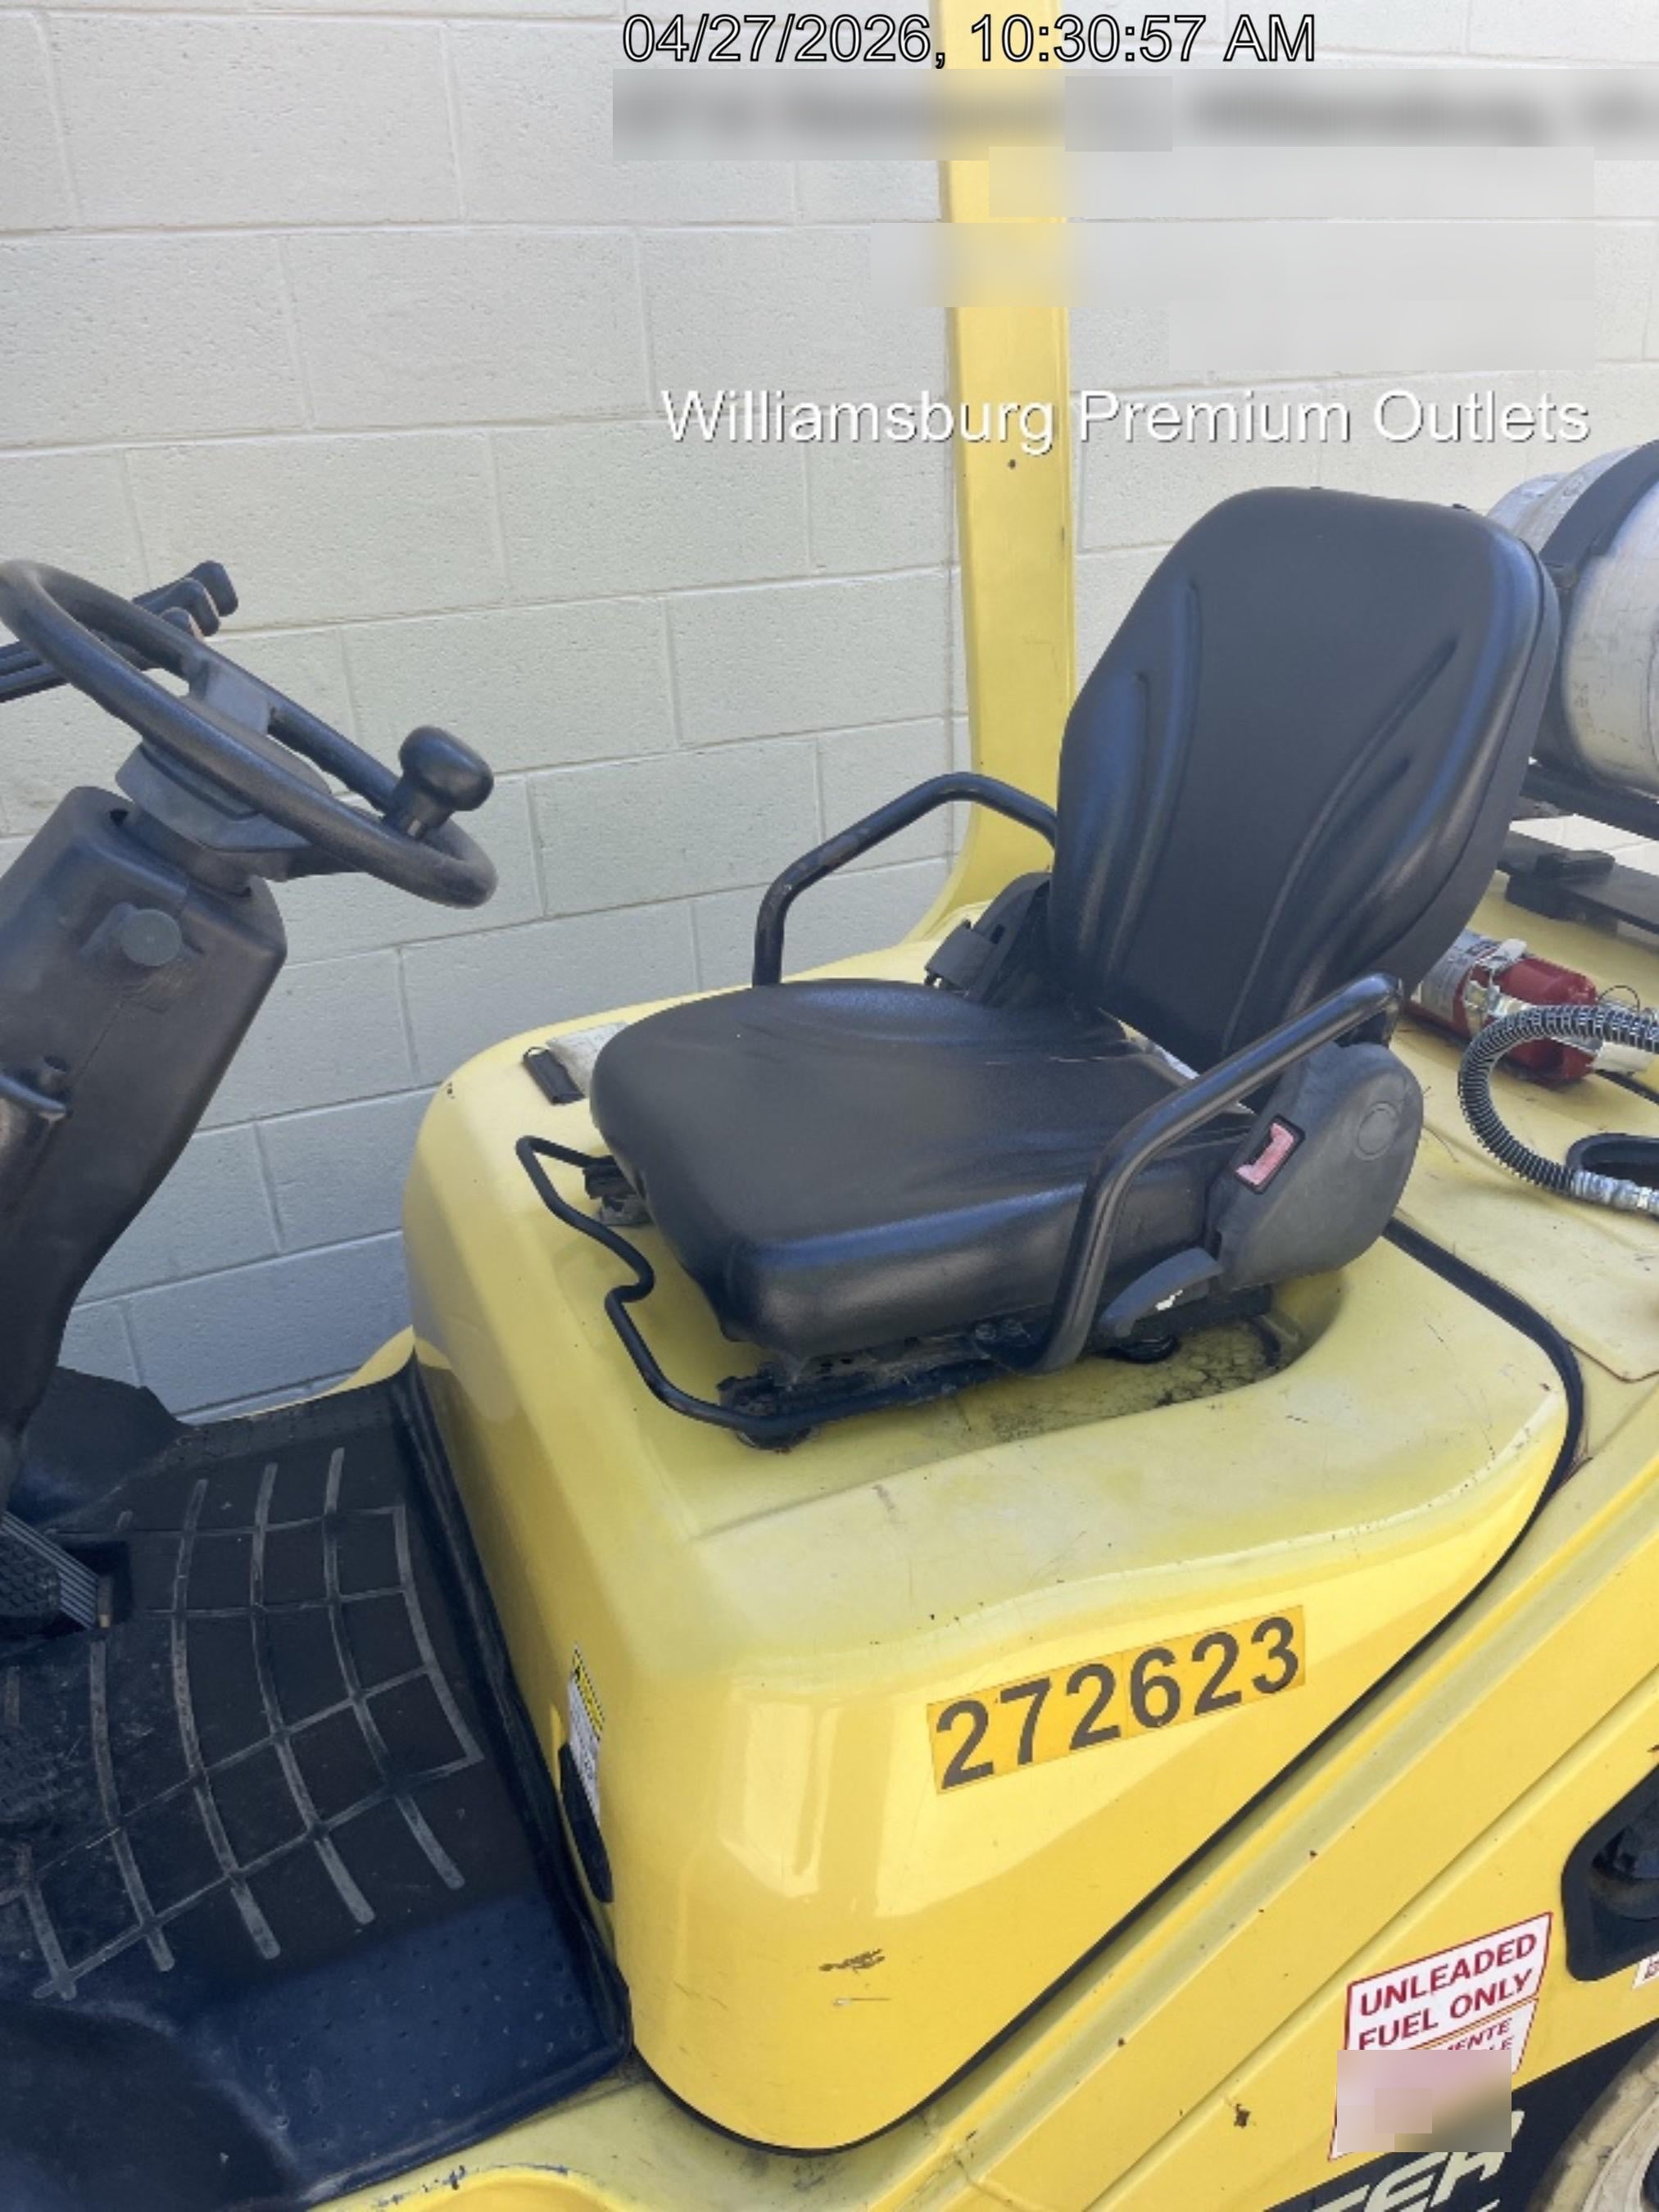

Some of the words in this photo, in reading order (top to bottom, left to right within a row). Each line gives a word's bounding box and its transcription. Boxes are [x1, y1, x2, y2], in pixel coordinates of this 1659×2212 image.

[936, 1616, 1300, 1790] 272623
[1358, 2007, 1439, 2051] FUEL
[1449, 1968, 1533, 2019] ONLY
[1360, 1933, 1538, 2016] UNLEADED
